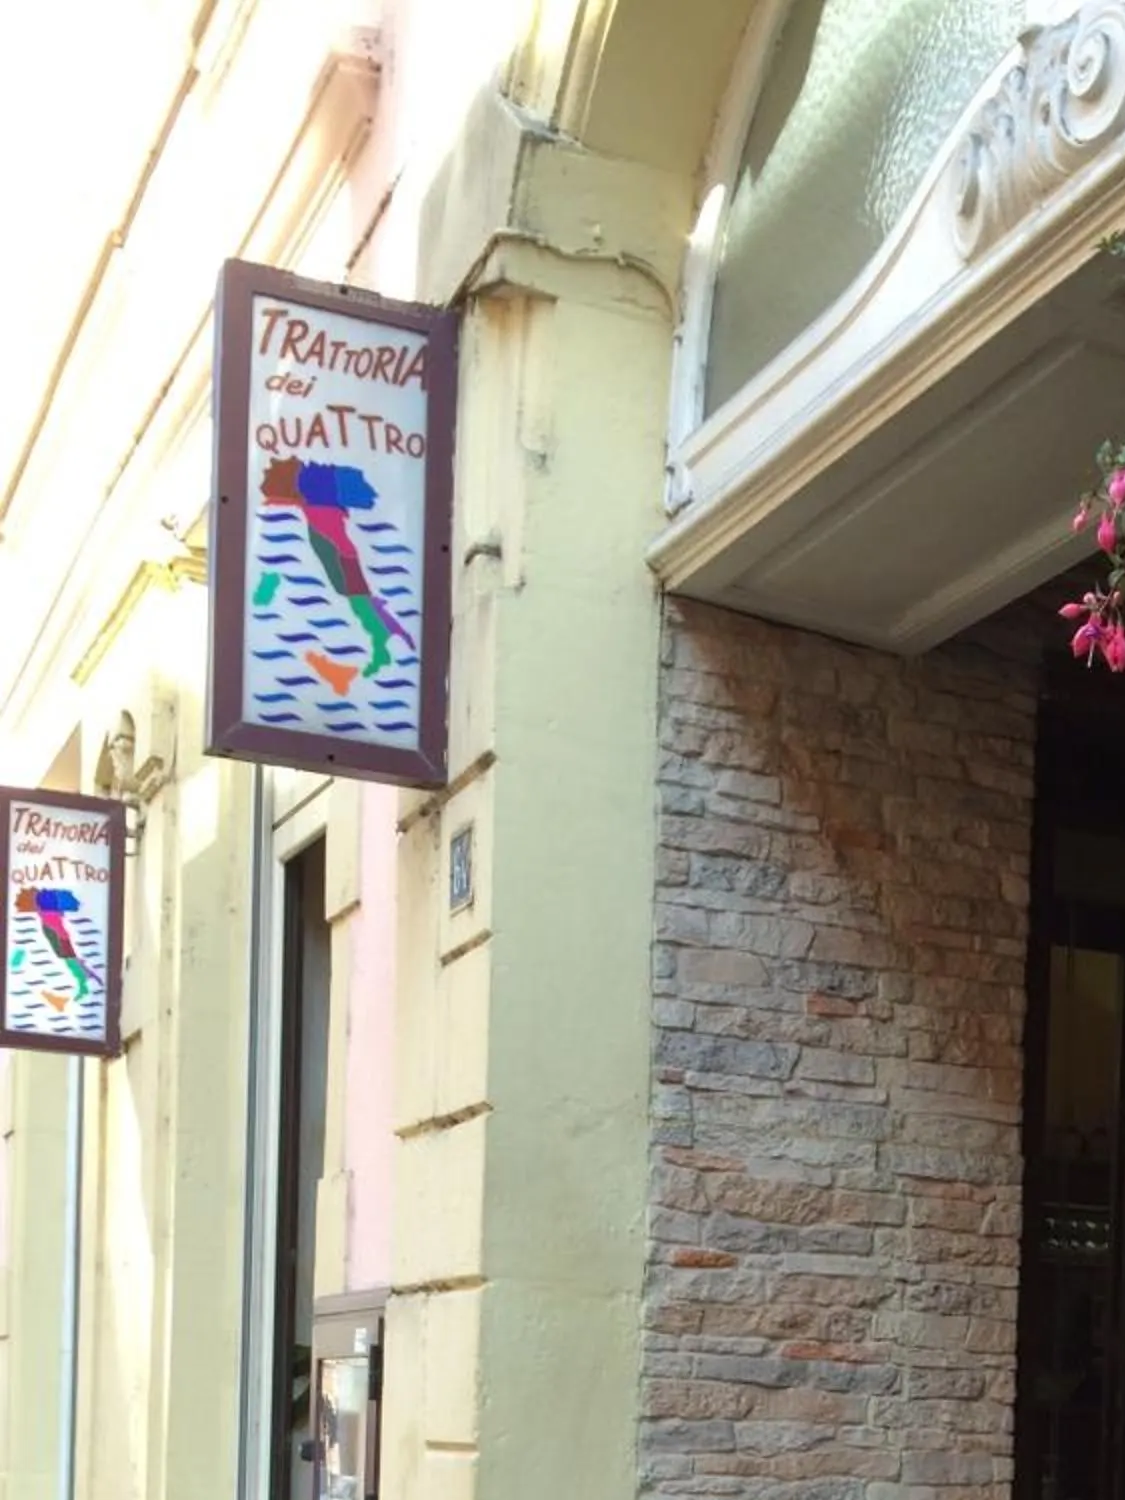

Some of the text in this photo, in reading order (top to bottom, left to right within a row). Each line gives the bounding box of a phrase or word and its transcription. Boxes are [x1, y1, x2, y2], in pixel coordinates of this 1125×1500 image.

[258, 308, 427, 392] TRATTORIA
[264, 371, 317, 398] dei
[256, 405, 425, 460] QUATTRO
[12, 807, 110, 846] TRATTORIA
[17, 840, 45, 854] dei
[11, 856, 109, 884] QUATTRO
